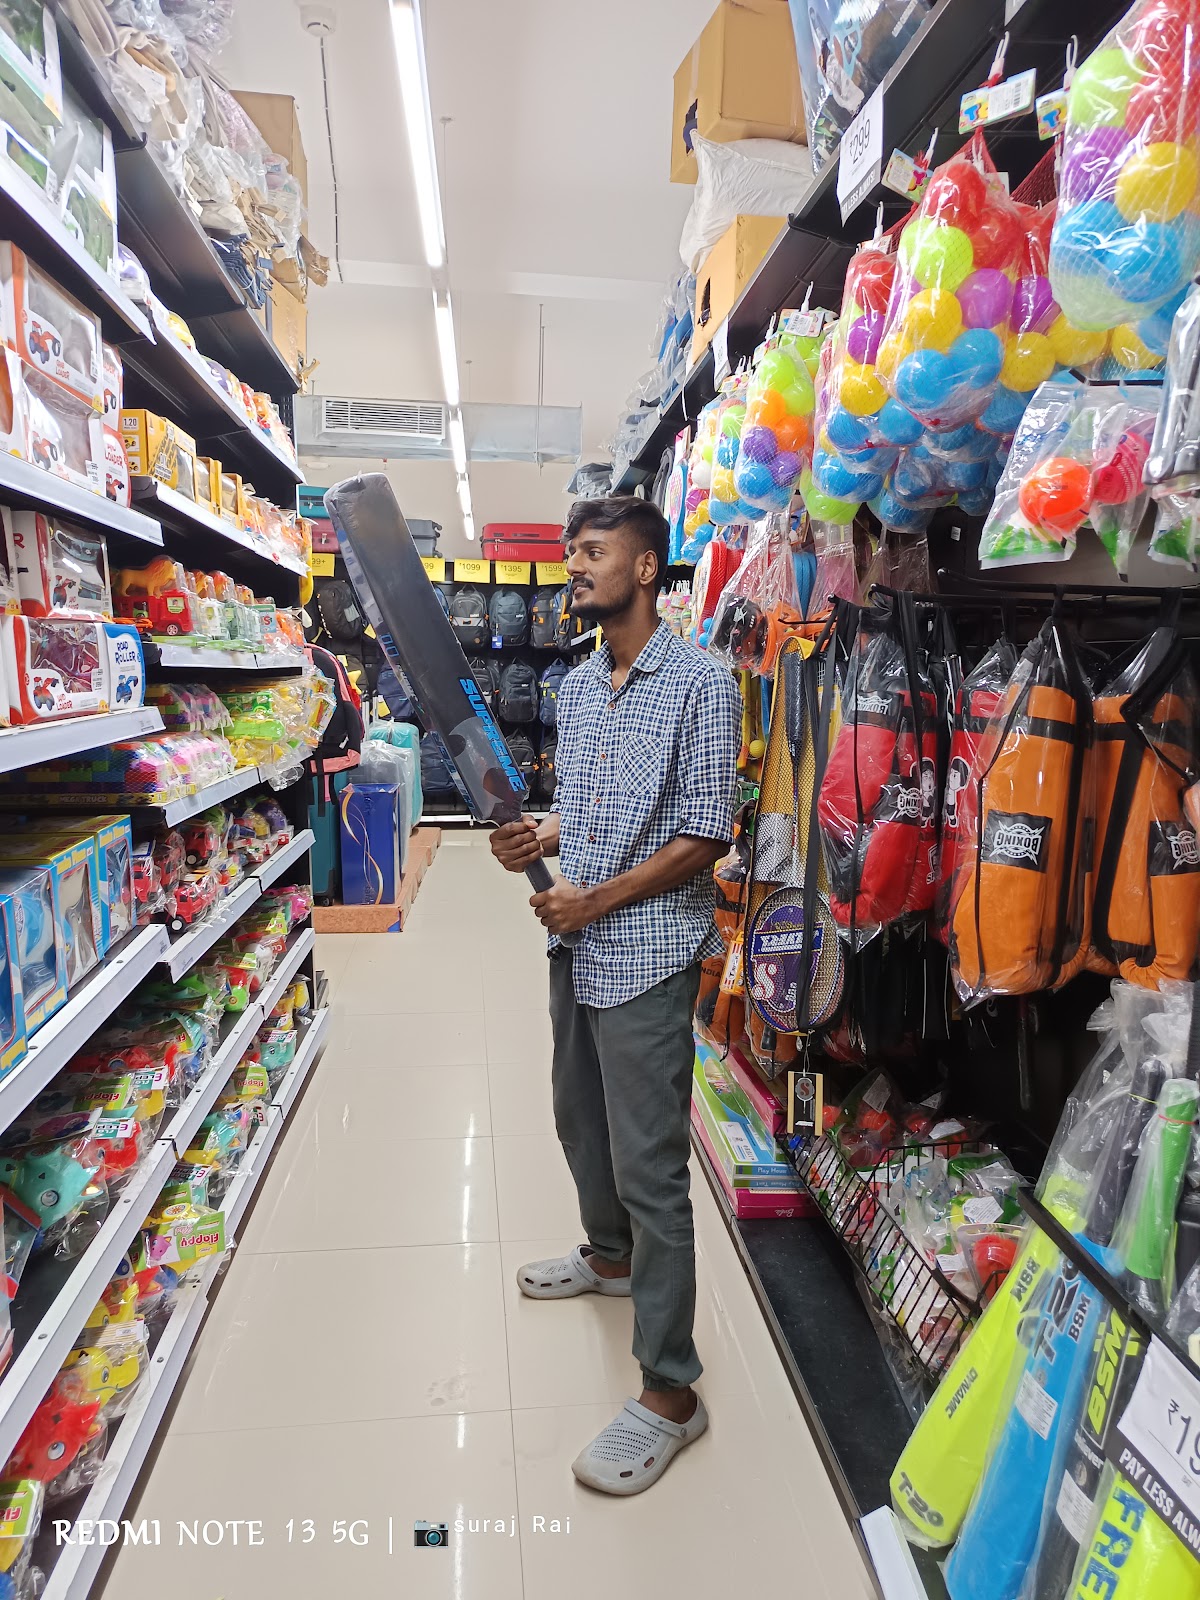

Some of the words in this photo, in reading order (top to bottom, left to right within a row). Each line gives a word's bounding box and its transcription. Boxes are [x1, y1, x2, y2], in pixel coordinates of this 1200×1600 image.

[123, 418, 137, 426] 1.20
[117, 641, 128, 652] ROAD
[115, 652, 136, 664] ROLLER
[56, 700, 73, 710] LOADER
[460, 678, 525, 792] SUPREME
[81, 796, 107, 804] TRUCK
[994, 830, 1042, 855] BOXING
[701, 966, 721, 978] NDIA
[774, 1208, 794, 1218] Barbie
[1010, 1256, 1041, 1303] BSM
[1067, 1293, 1092, 1344] BSM
[1088, 1308, 1126, 1435] BSM
[945, 1367, 978, 1419] DYNAMIC
[1118, 1448, 1146, 1481] PAY
[1142, 1471, 1174, 1517] LESS
[1172, 1511, 1200, 1556] ALW
